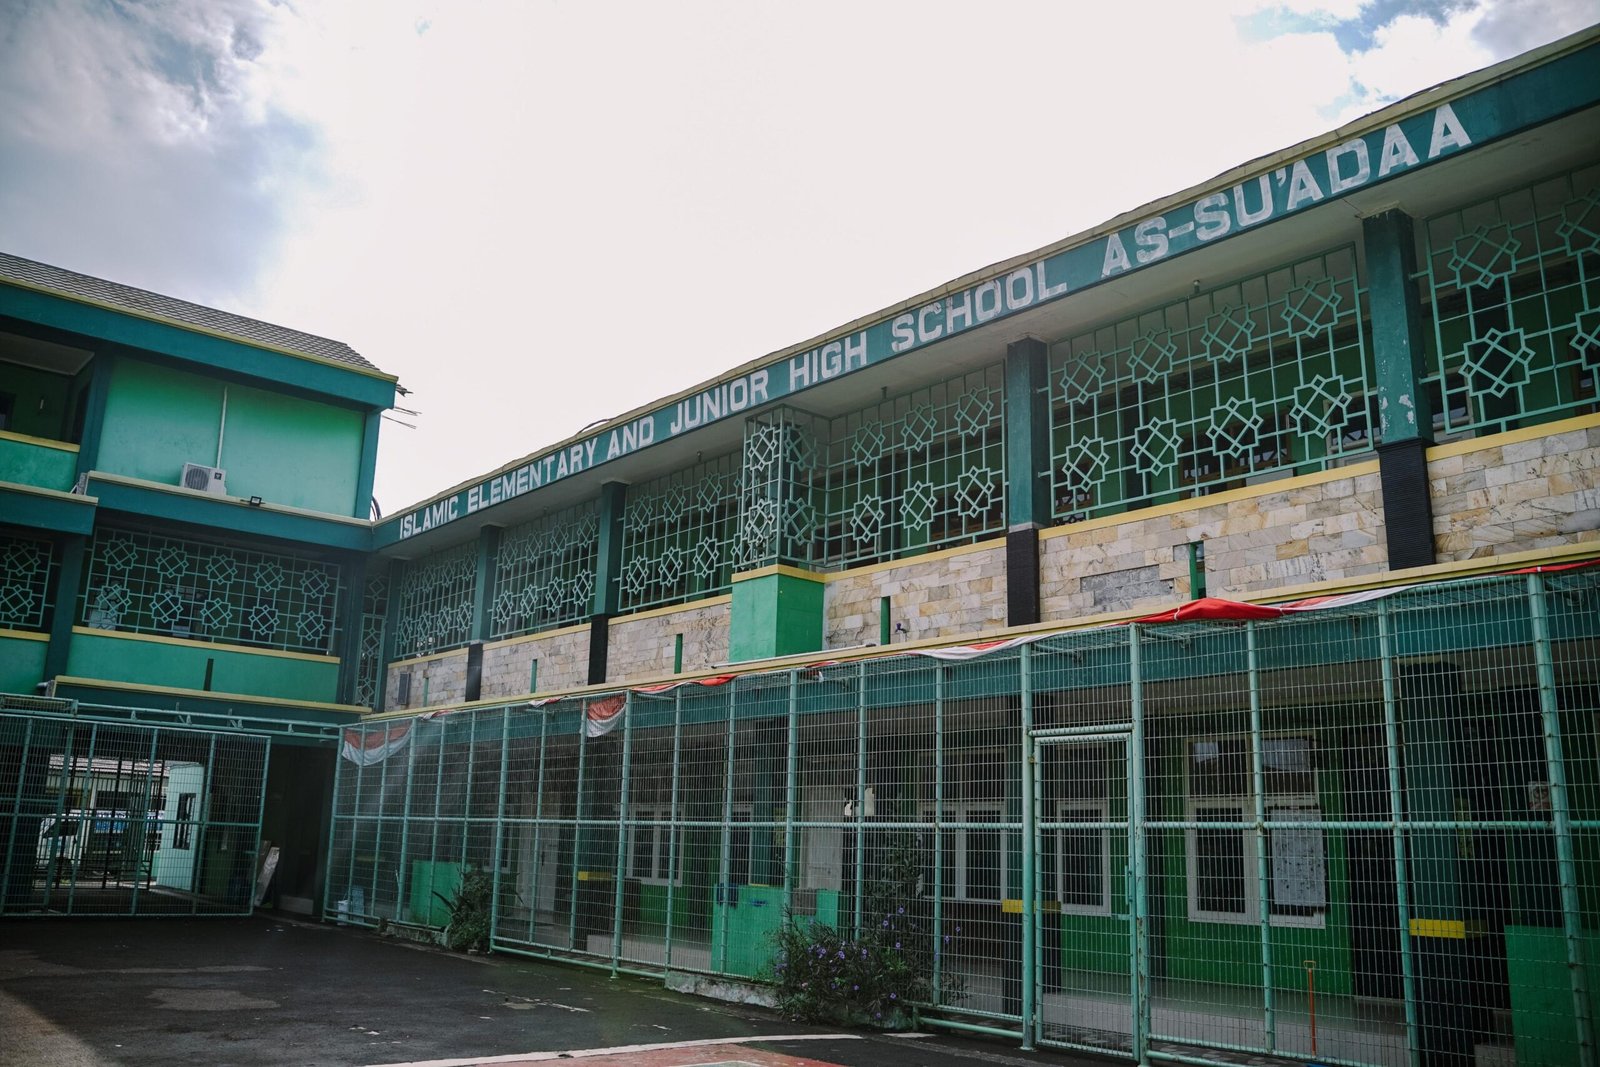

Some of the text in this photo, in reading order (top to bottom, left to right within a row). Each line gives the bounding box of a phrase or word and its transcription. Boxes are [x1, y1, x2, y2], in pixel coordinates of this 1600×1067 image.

[400, 103, 1472, 539] ISLAMIC ELEMENTARY AND JUNIOR HIGH SCHOOL AS-SU'ADAA
